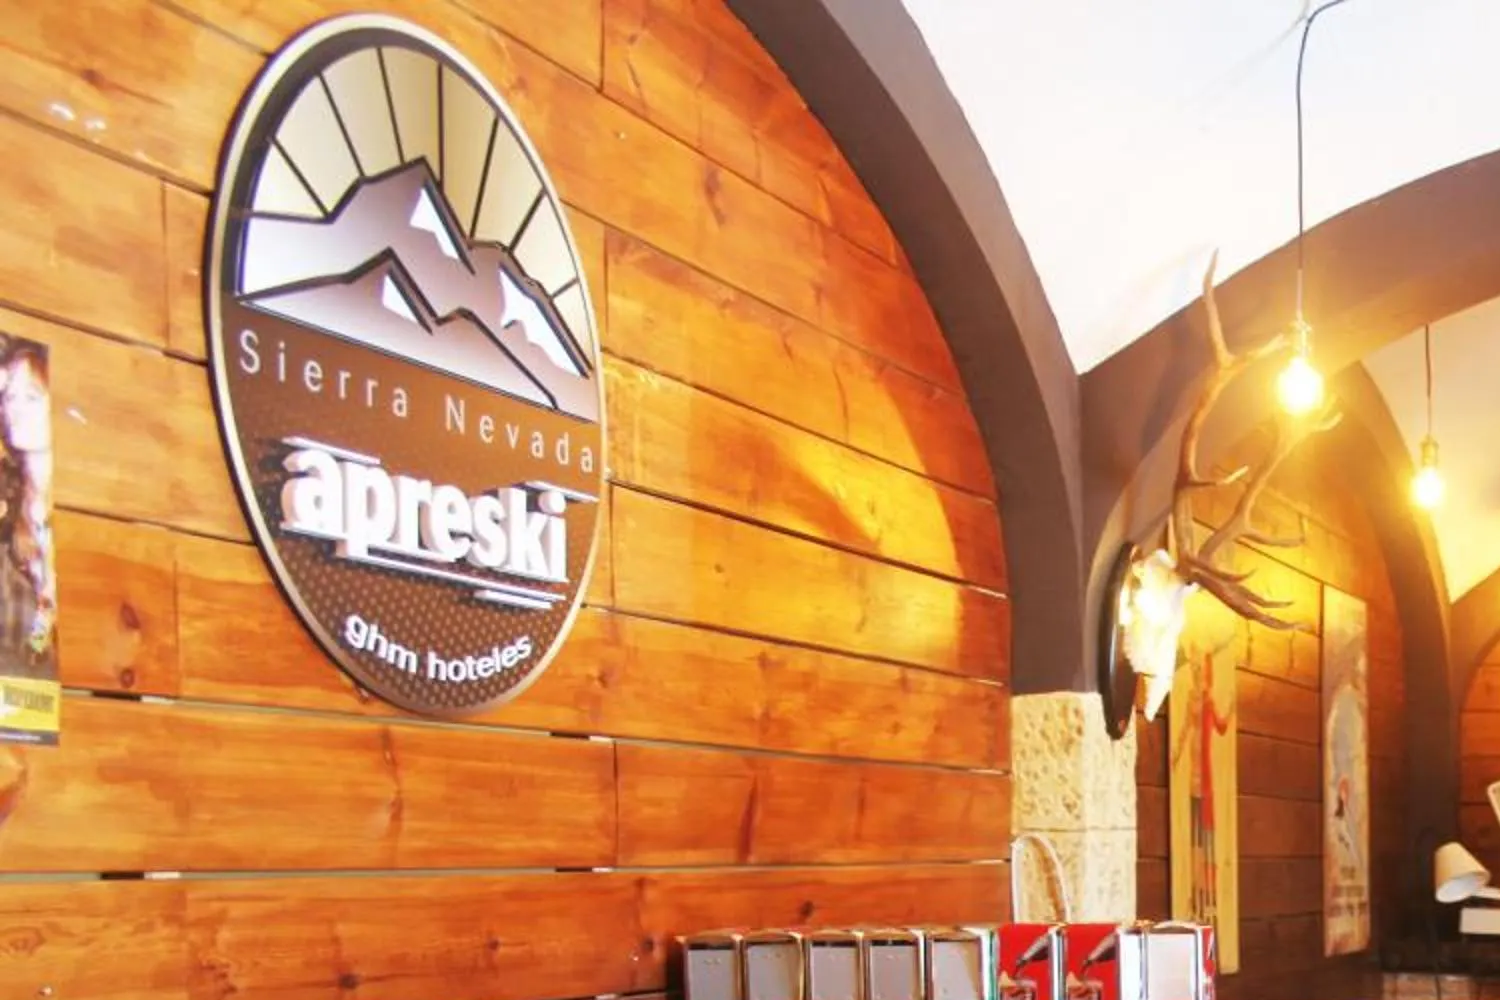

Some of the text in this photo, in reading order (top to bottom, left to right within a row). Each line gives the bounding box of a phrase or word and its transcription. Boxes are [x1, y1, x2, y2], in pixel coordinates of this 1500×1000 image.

[239, 329, 594, 473] Sierra Nevada
[281, 448, 569, 583] apreski
[343, 614, 533, 682] ghm hoteles
